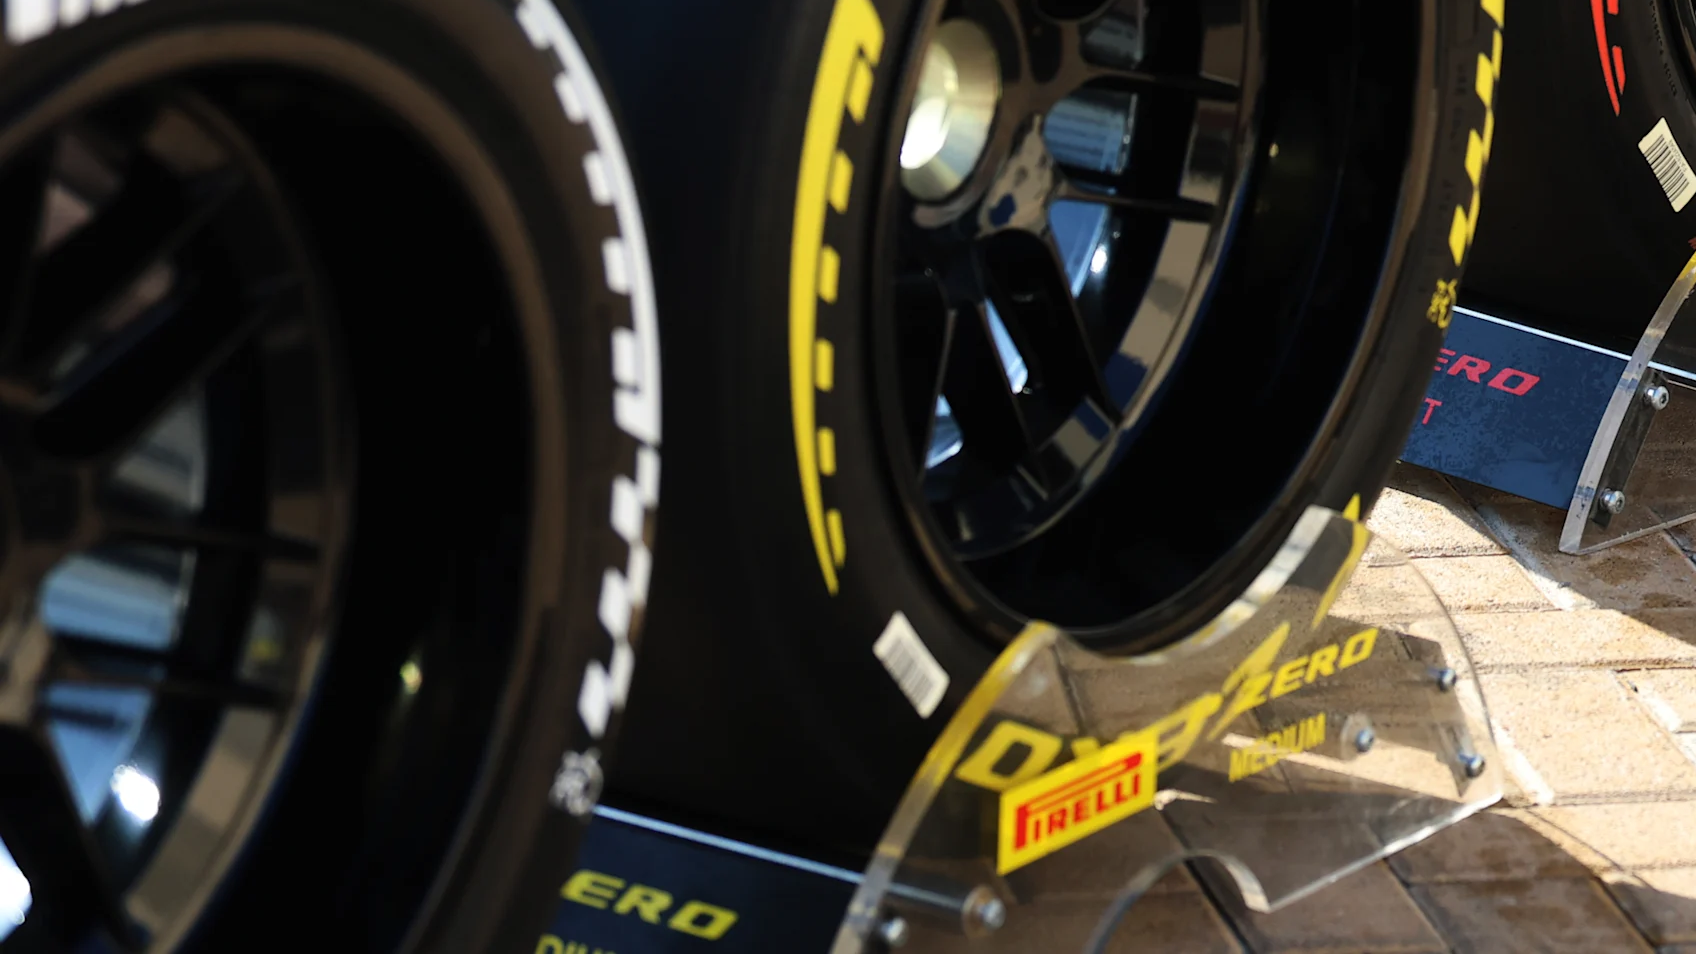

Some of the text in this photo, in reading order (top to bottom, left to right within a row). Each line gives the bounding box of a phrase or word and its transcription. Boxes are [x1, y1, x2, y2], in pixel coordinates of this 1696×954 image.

[1233, 628, 1378, 714] ZERO
[1228, 712, 1326, 783] MEDIUM
[1015, 752, 1143, 852] PIRELLI
[560, 869, 740, 941] ERO
